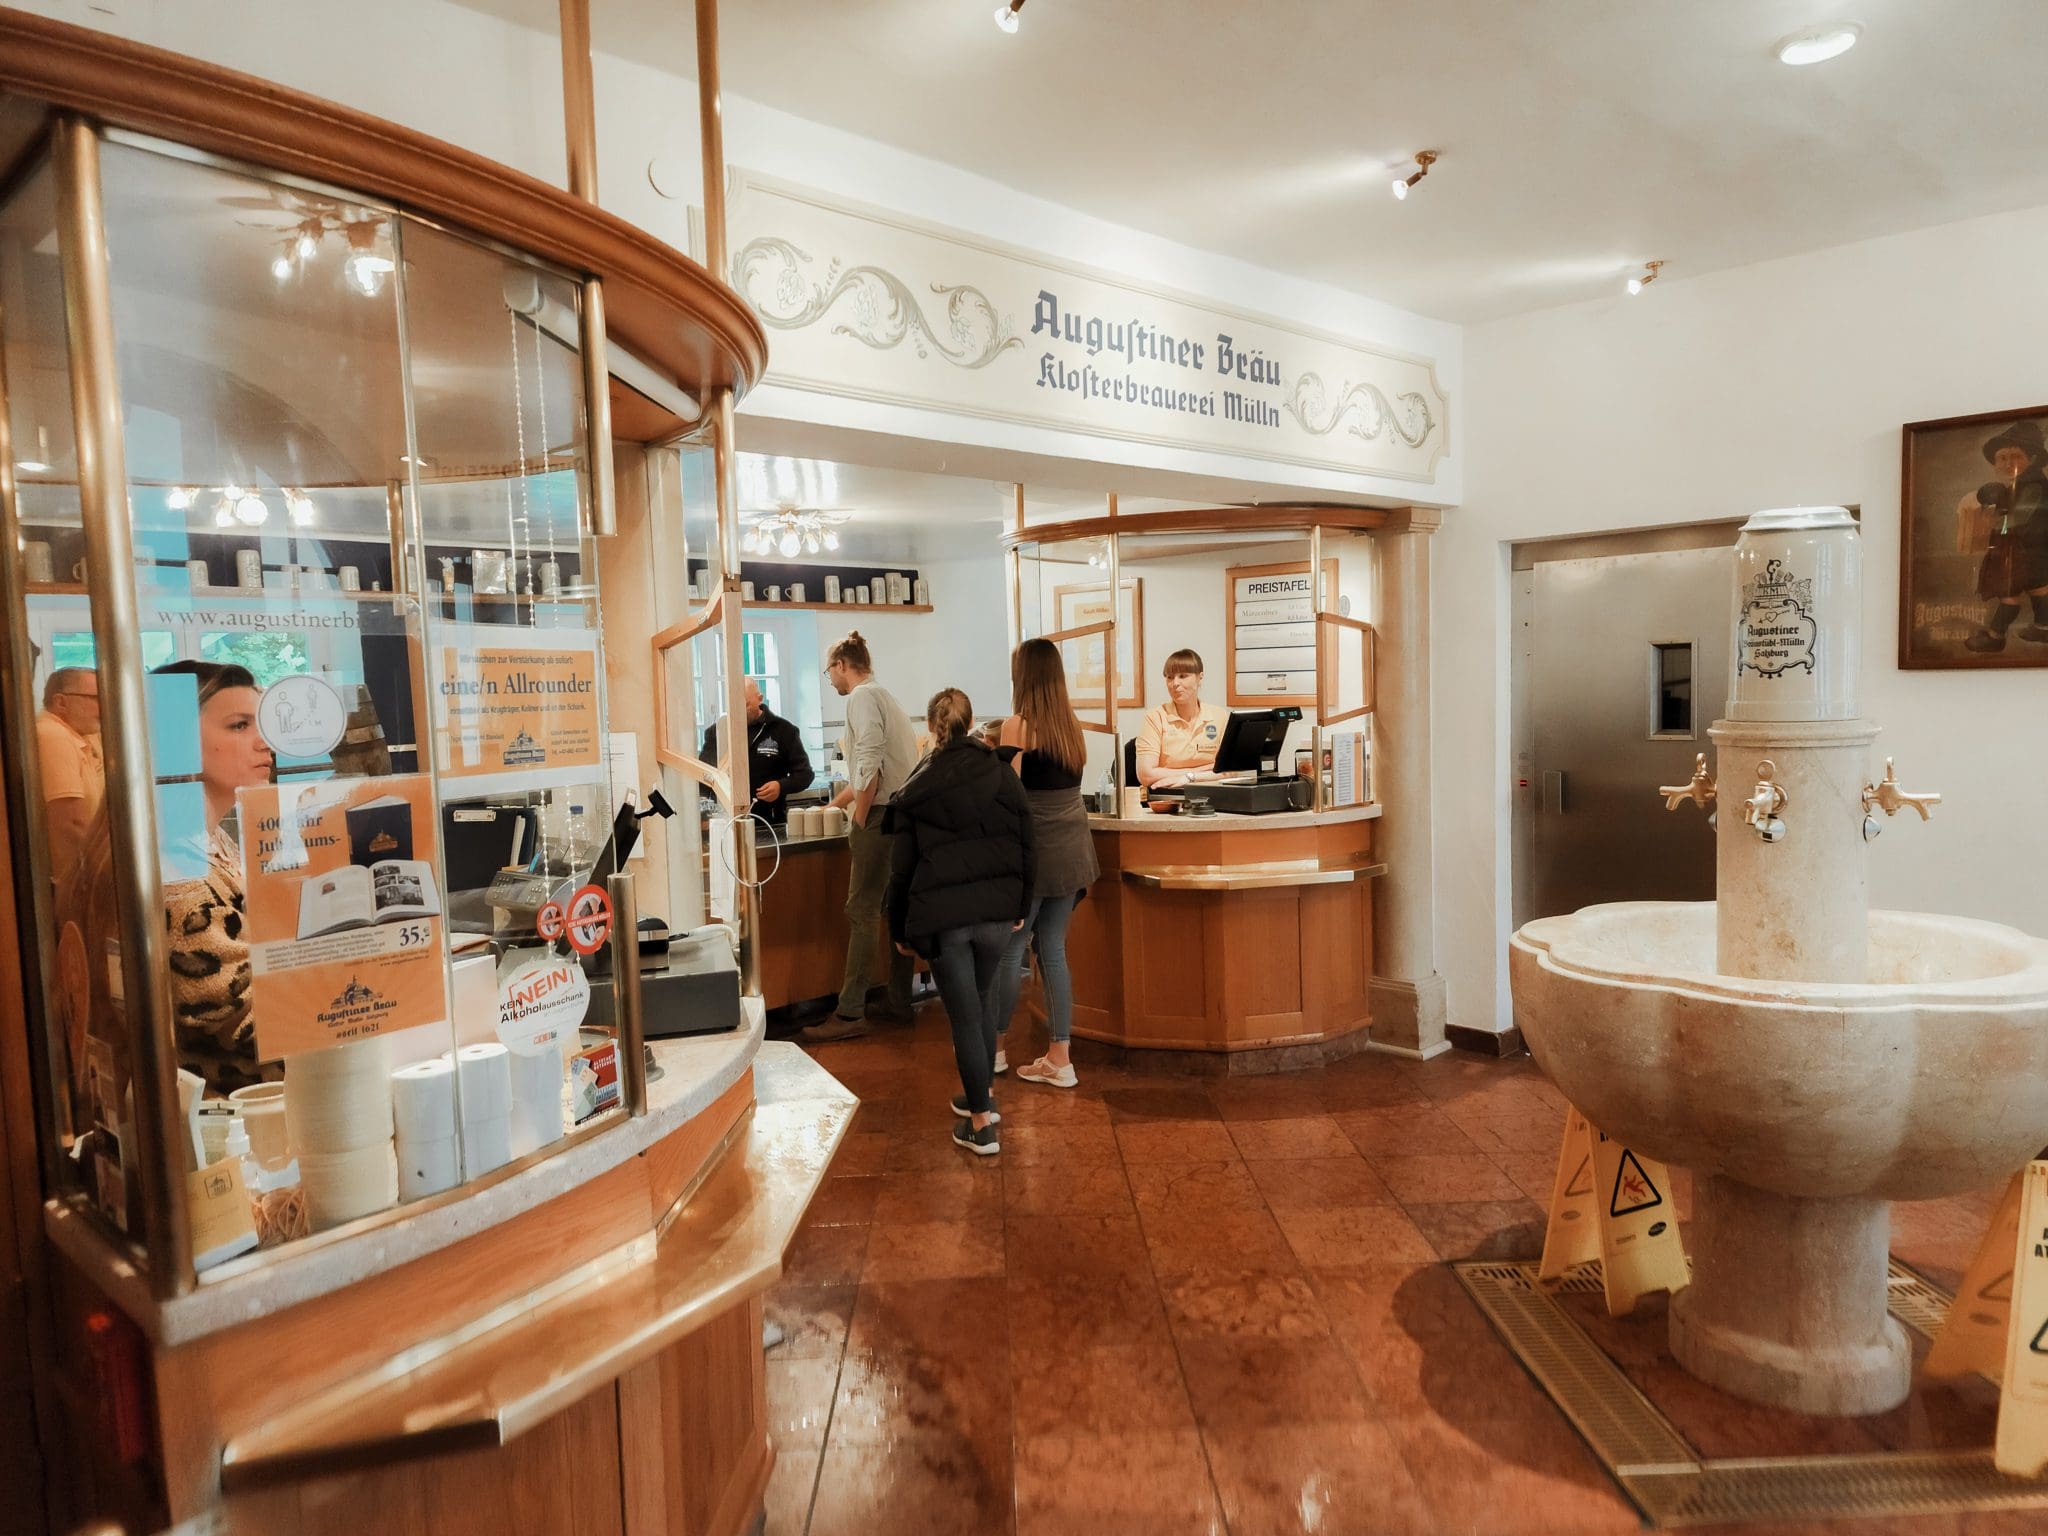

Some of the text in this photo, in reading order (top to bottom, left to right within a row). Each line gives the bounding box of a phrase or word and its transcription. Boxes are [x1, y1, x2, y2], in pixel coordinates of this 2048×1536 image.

[1216, 333, 1281, 386] Bräu
[1223, 390, 1281, 428] Mülln
[1248, 580, 1310, 595] PREISTAFEL
[1747, 624, 1800, 637] Augustiner
[1754, 648, 1789, 660] Salzburg
[440, 672, 592, 696] eine/n Allrounder
[515, 967, 568, 1010] NEIN
[500, 998, 523, 1012] KEIN
[501, 991, 584, 1024] Alkoholausschank
